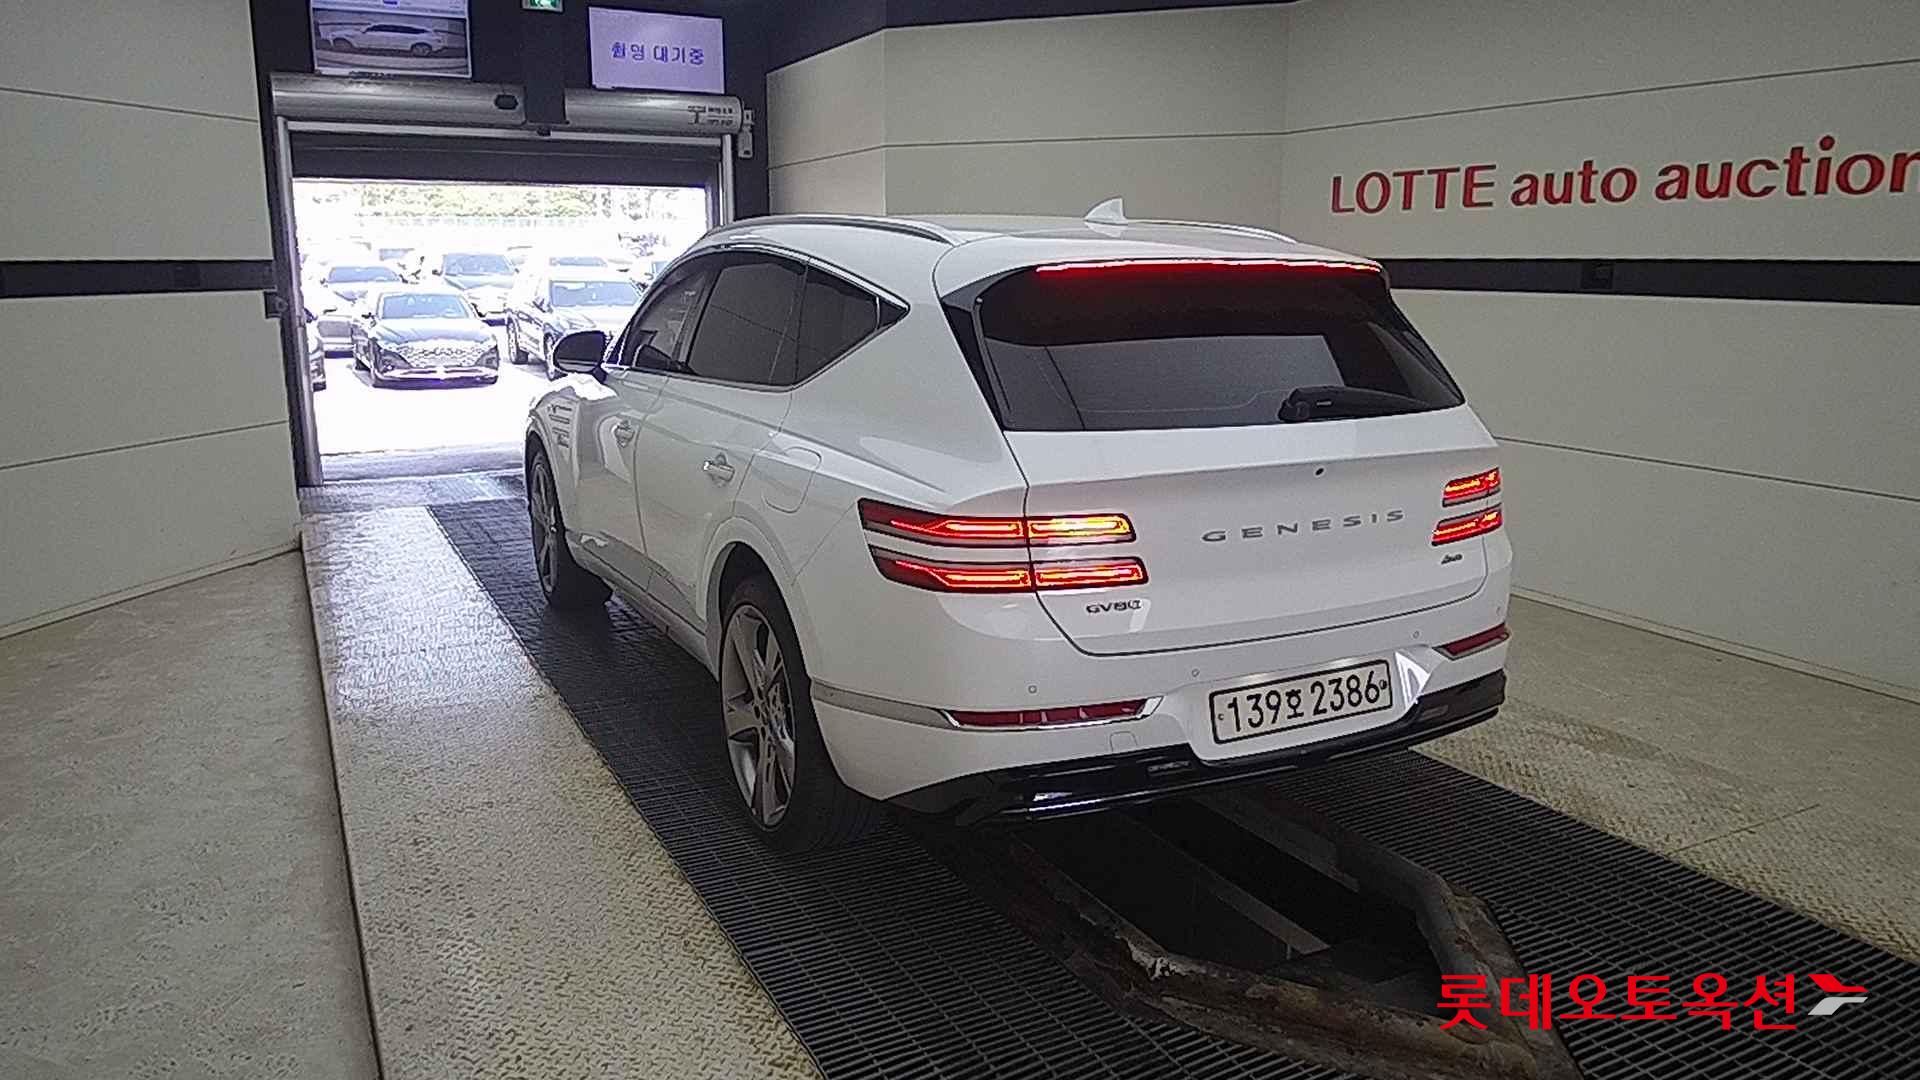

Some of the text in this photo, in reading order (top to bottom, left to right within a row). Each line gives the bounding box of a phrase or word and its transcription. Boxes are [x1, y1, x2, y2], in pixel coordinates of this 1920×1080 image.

[653, 45, 704, 66] 대기중
[1331, 135, 1920, 214] LOTTE auto auction
[1201, 509, 1404, 543] GENESIS
[1086, 599, 1141, 613] GV80
[1227, 670, 1381, 732] 139호 2386
